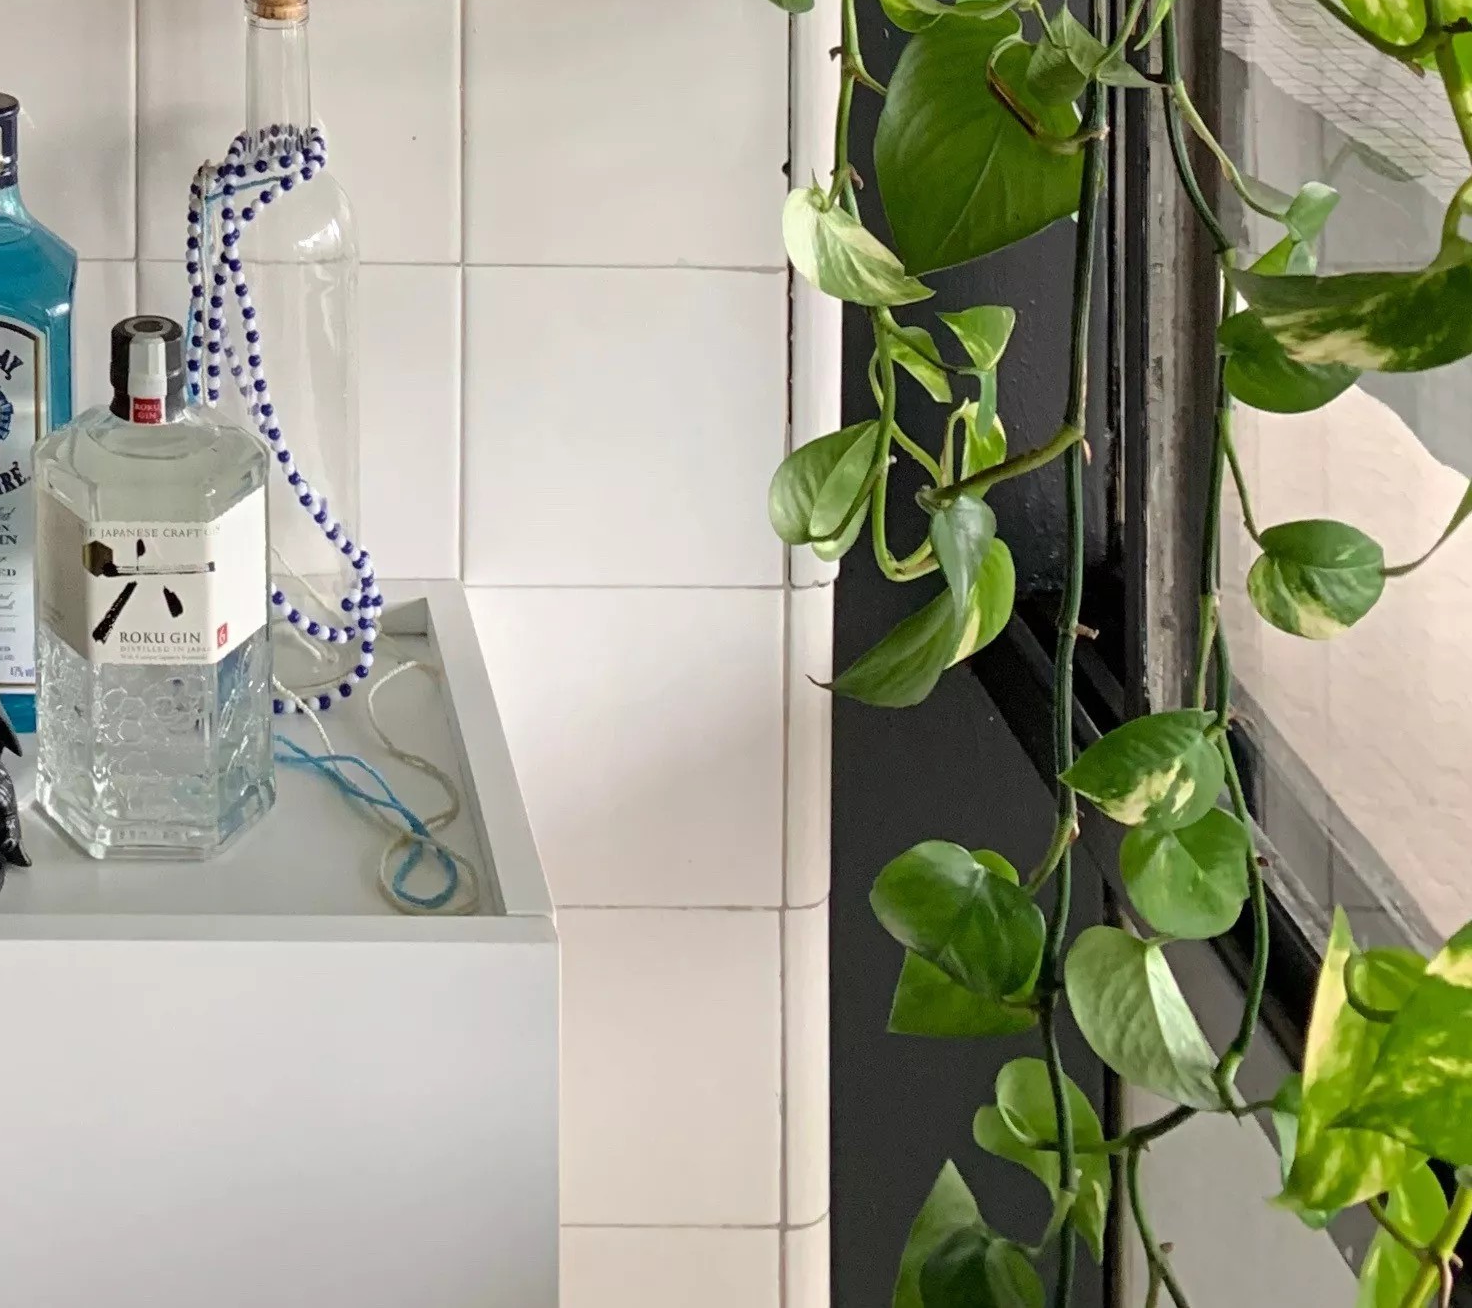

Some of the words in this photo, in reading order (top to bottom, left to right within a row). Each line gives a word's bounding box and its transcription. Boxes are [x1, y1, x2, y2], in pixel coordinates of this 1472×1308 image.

[101, 528, 158, 538] JAPANESE
[163, 528, 203, 538] CRAFT
[120, 632, 165, 643] ROKU
[170, 632, 201, 643] GIN
